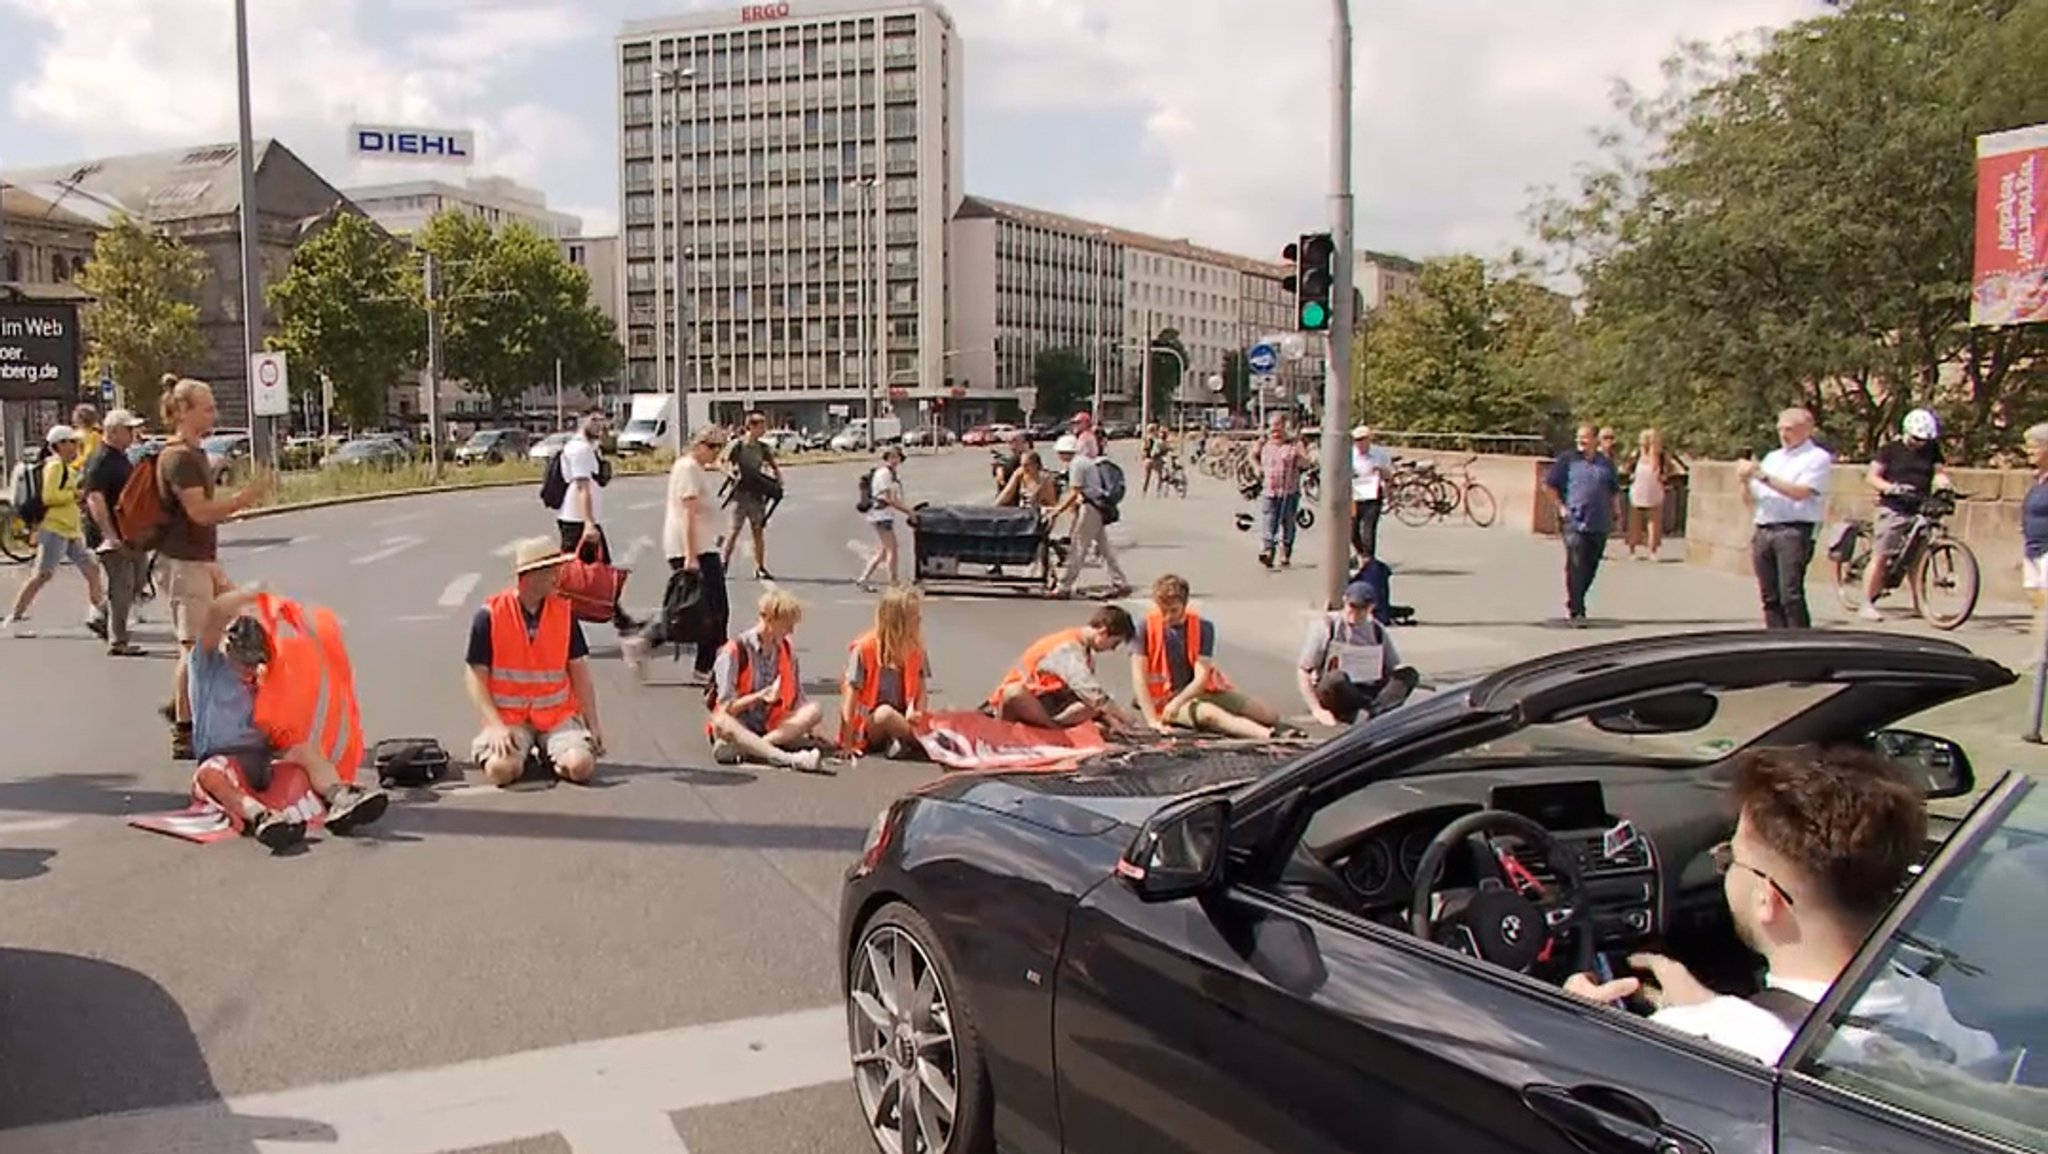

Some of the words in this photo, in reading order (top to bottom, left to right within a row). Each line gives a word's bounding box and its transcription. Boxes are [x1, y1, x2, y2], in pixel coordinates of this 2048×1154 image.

[742, 3, 789, 23] ERGO
[359, 131, 466, 155] DIEHL
[2, 317, 22, 336] im
[25, 317, 63, 337] Web
[0, 363, 59, 383] berg.de
